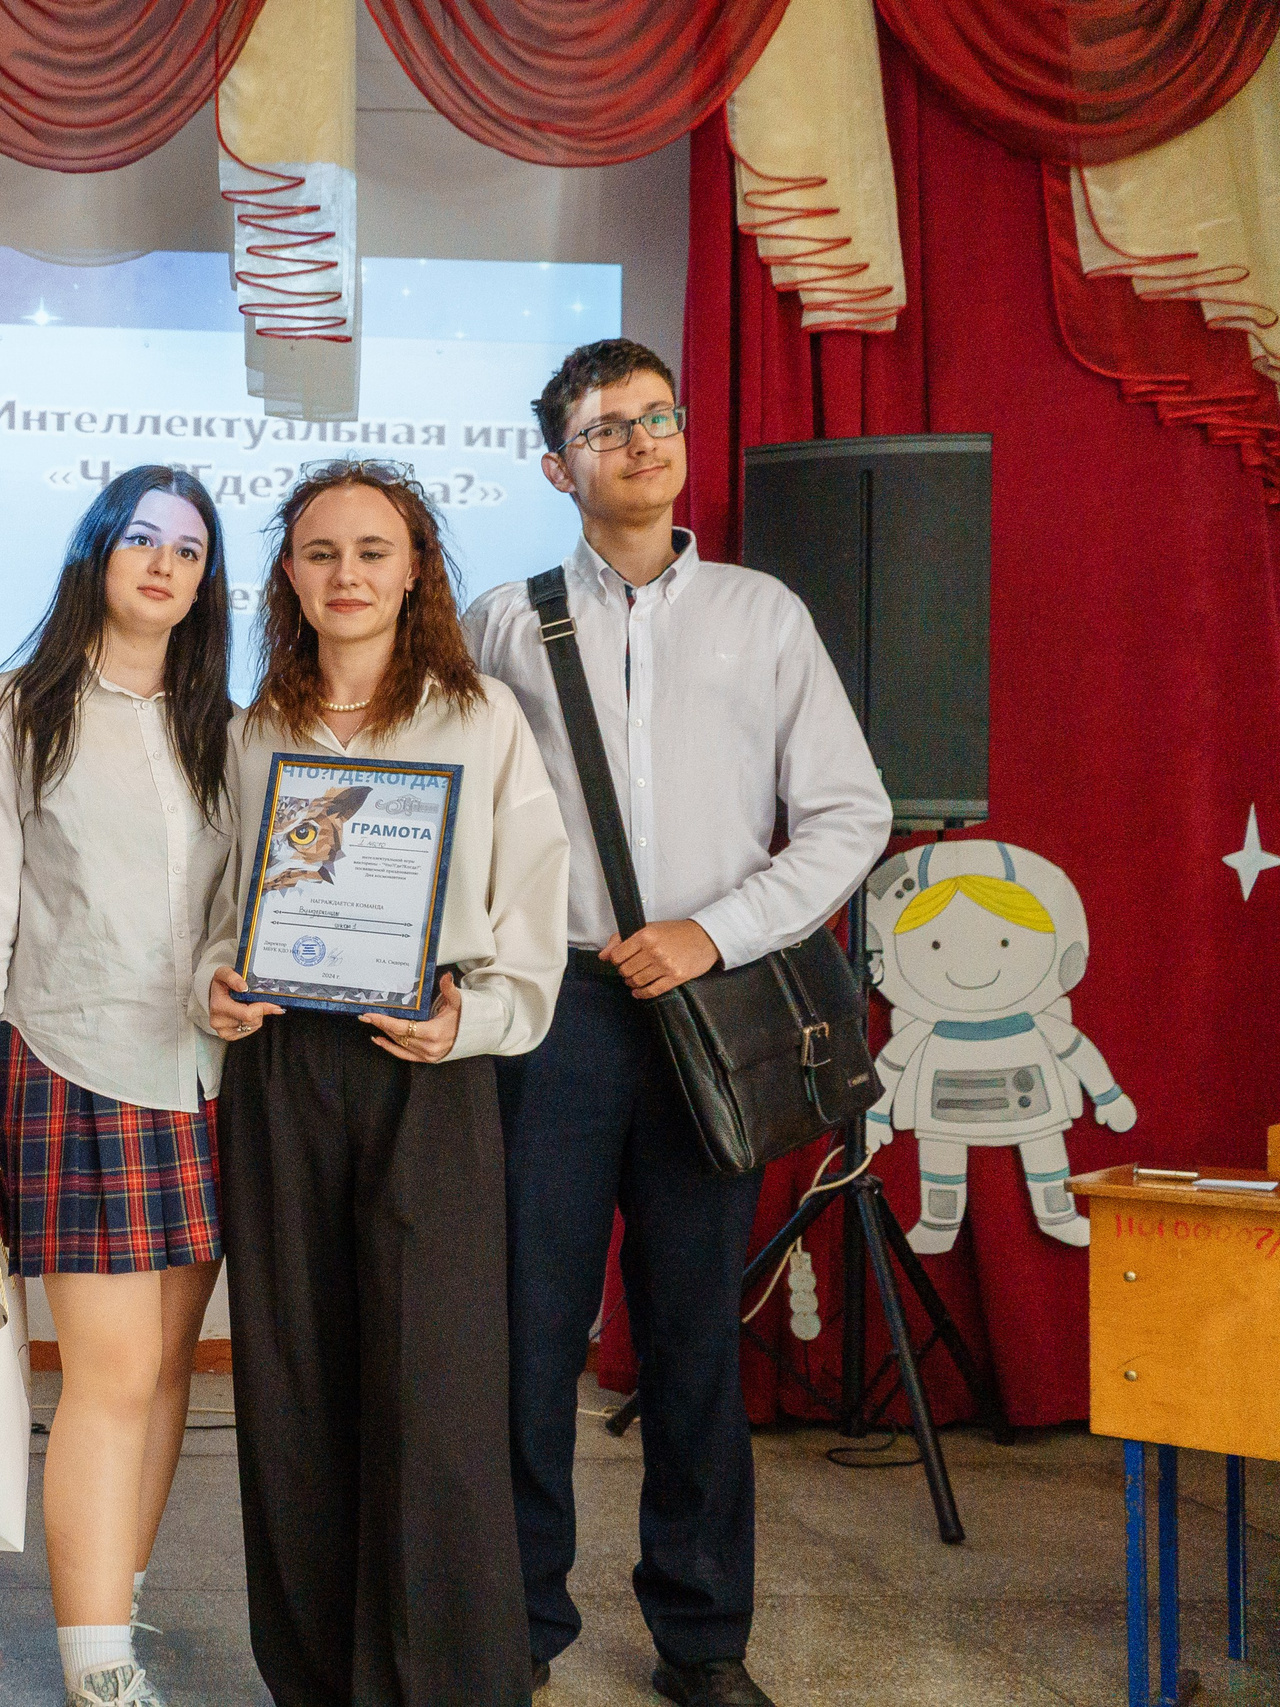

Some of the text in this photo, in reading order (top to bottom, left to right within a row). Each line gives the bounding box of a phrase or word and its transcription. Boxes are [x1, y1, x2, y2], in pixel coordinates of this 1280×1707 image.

[464, 424, 545, 460] игр
[351, 822, 432, 840] ГРАМОТА
[310, 899, 384, 910] НАГРАЖДАЕТСЯ КОМАНДА
